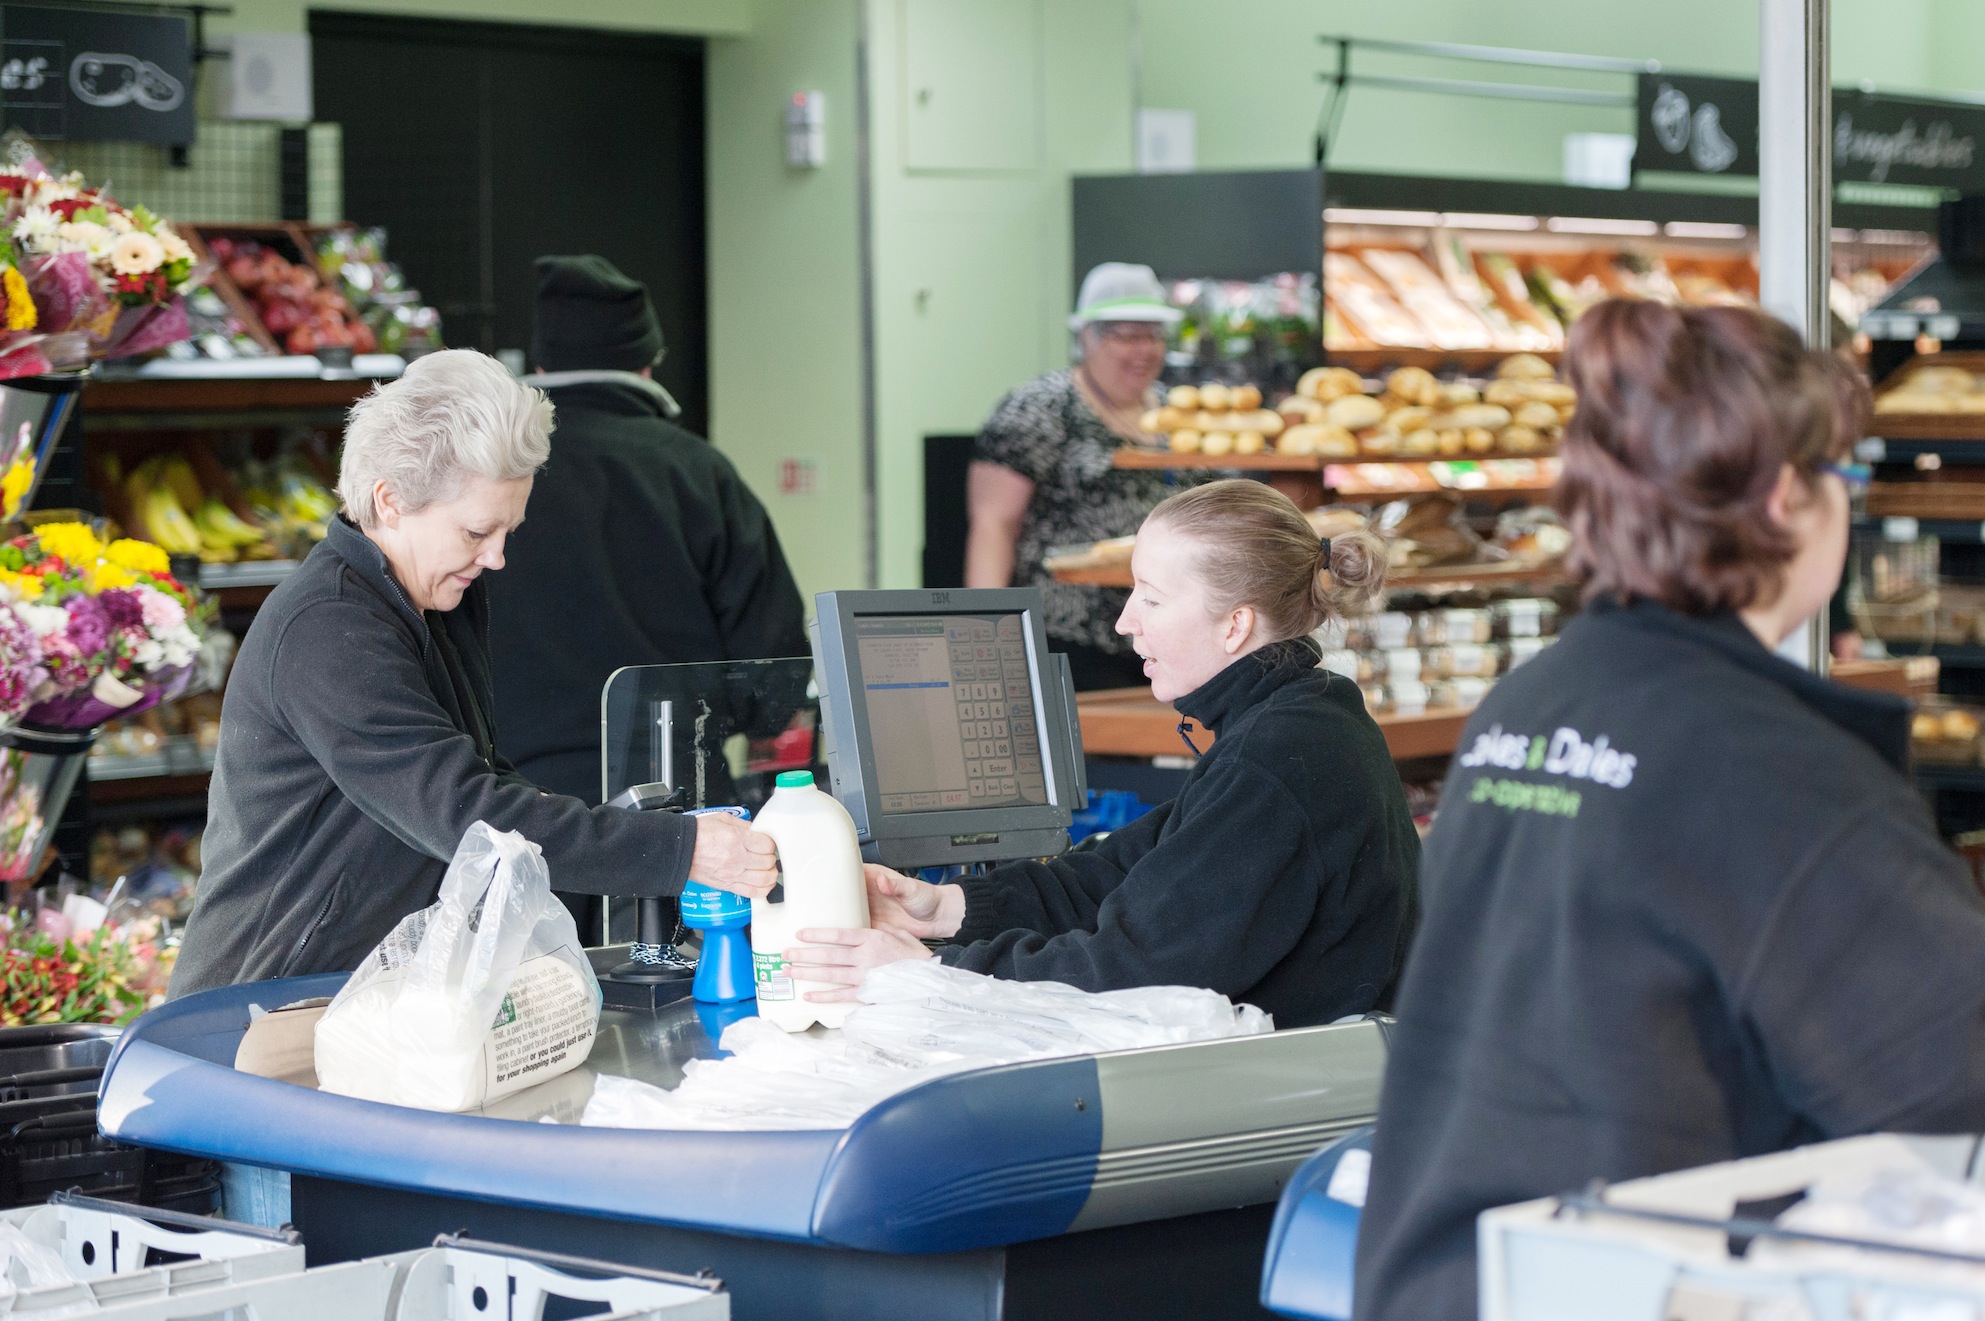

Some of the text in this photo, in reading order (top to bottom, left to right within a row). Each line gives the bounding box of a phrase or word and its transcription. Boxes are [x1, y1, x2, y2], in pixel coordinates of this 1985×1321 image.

[931, 592, 951, 605] IBM
[998, 744, 1008, 754] 00
[1544, 727, 1638, 789] Dales
[989, 764, 1008, 774] Enter
[408, 918, 417, 939] muddy
[495, 1036, 522, 1051] something
[552, 1017, 570, 1031] packed
[511, 1022, 524, 1036] paint
[496, 1051, 509, 1062] work
[522, 1042, 535, 1054] paint
[534, 1036, 549, 1048] brush
[510, 1055, 529, 1068] cabinet
[530, 1053, 537, 1061] or
[538, 1048, 549, 1060] you
[549, 1040, 566, 1054] could
[566, 1035, 577, 1049] just
[577, 1032, 587, 1042] use
[496, 1052, 567, 1083] for your shopping again
